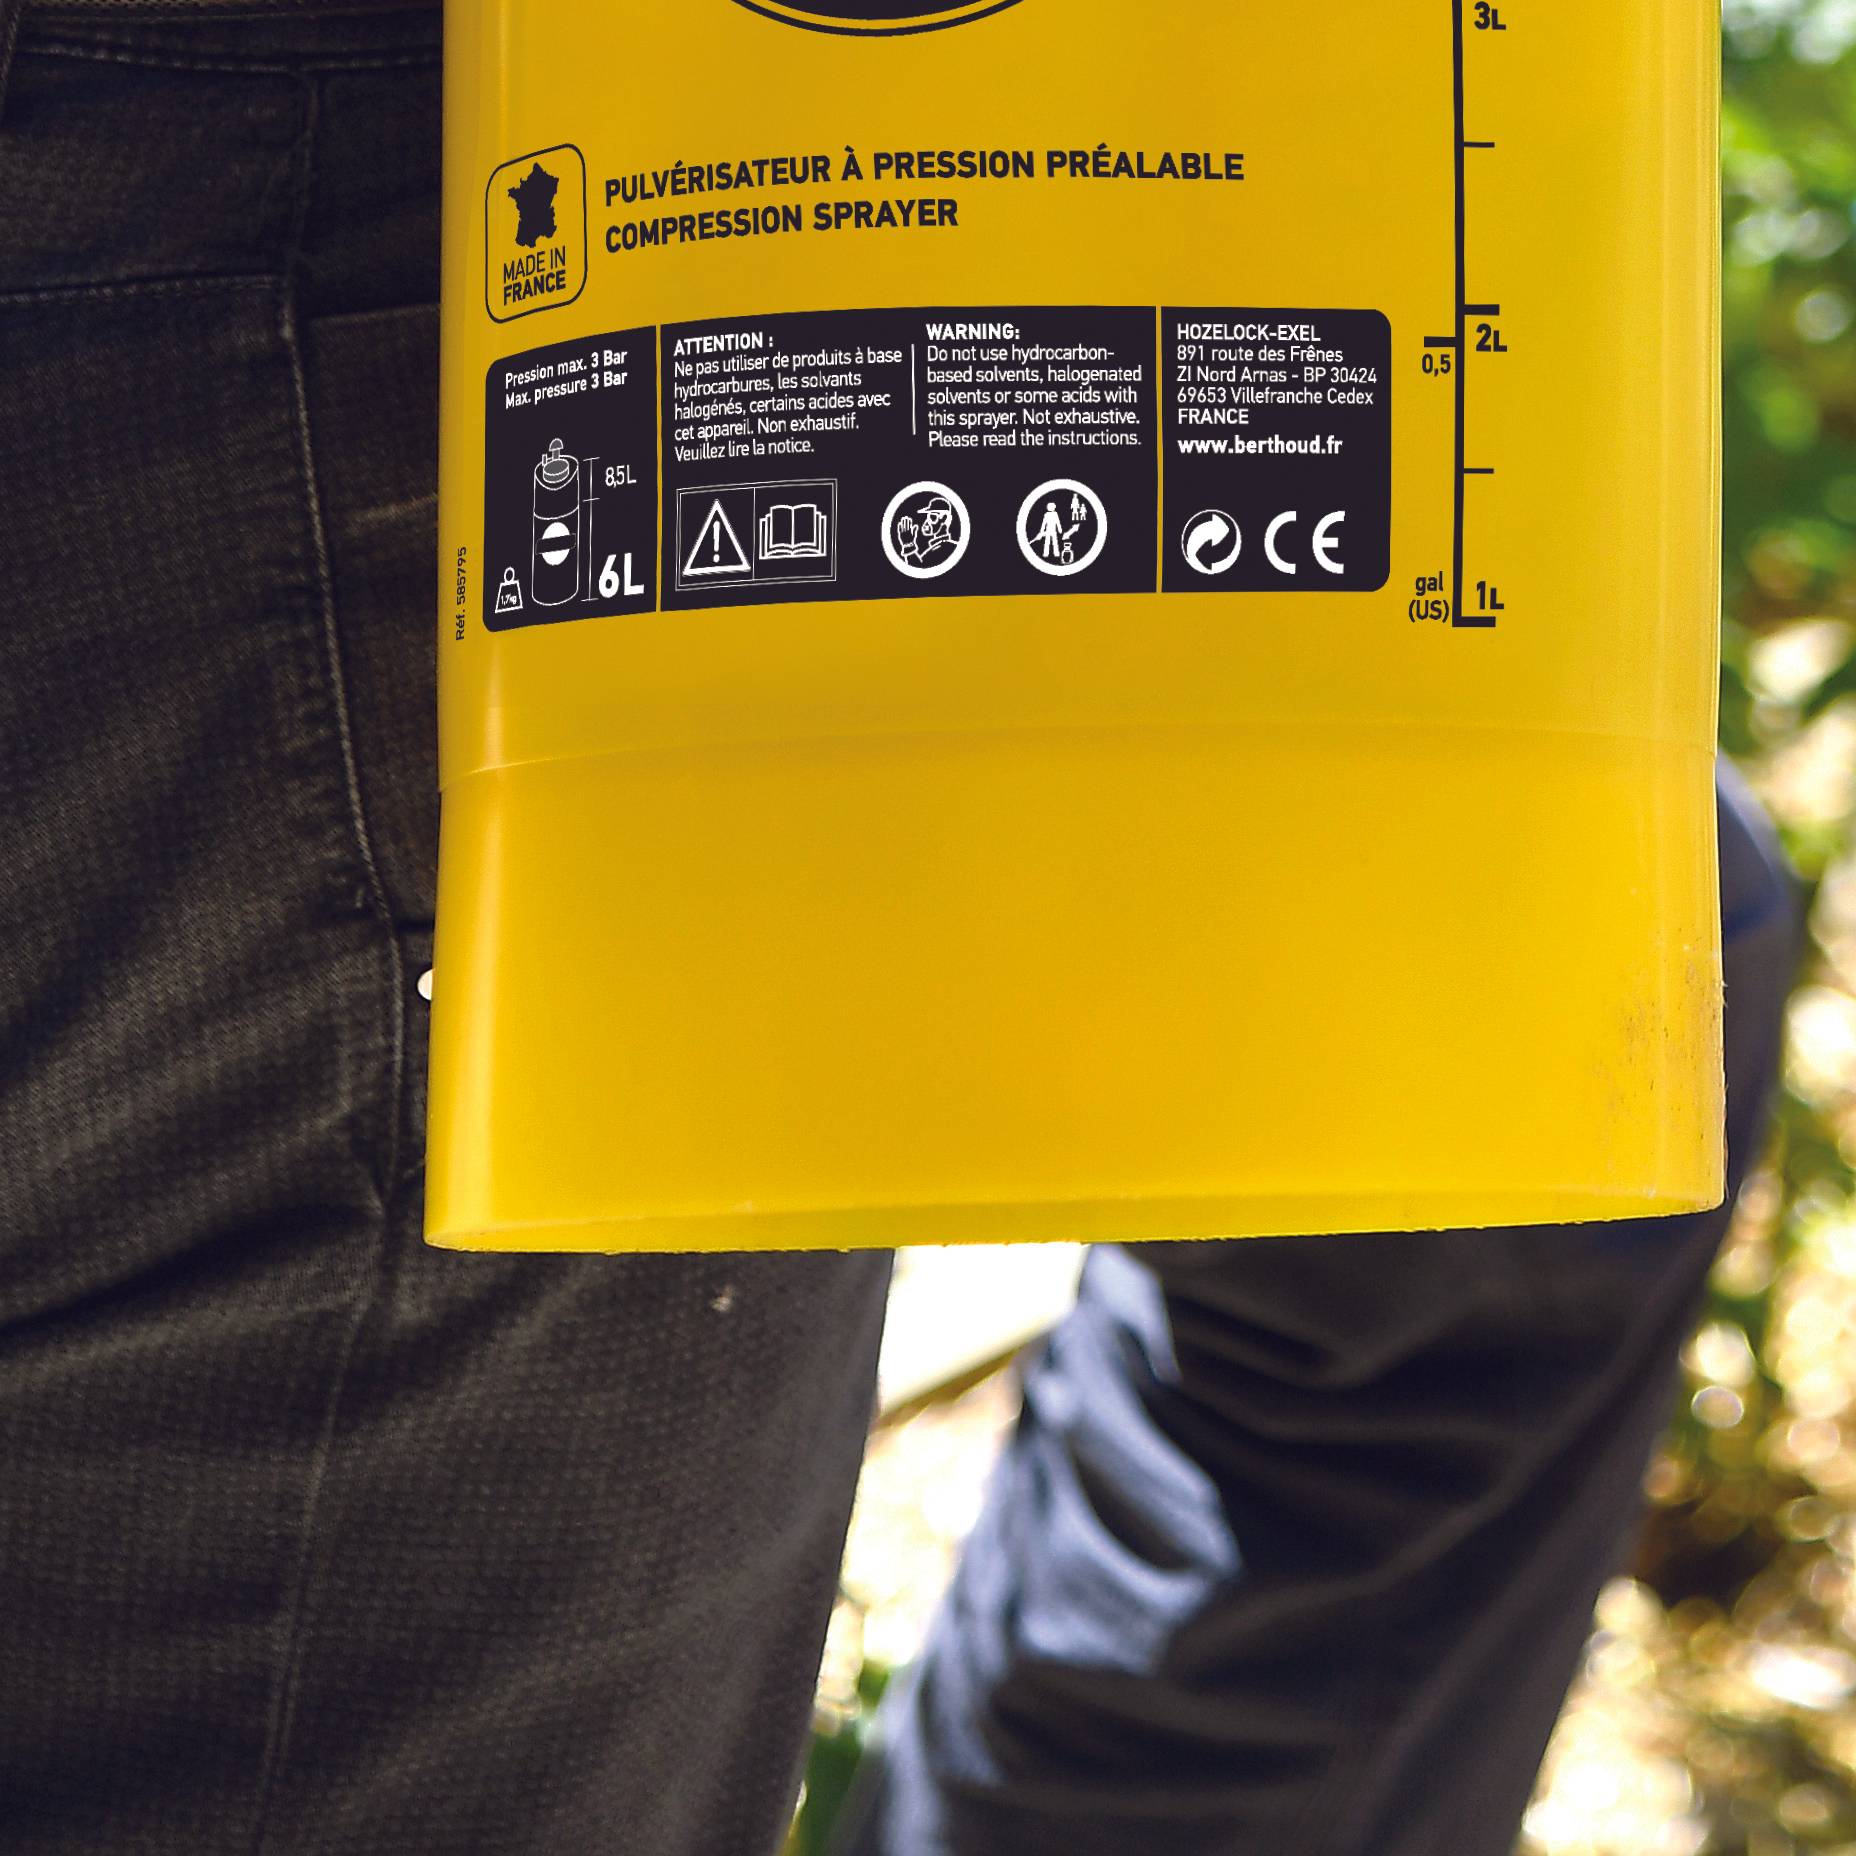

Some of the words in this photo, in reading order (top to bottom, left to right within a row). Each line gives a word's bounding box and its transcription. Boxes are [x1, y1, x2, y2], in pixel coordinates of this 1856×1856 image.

[1472, 1, 1506, 31] 3L
[605, 155, 831, 207] PULVÉRISATEUR
[841, 145, 863, 181] À
[873, 150, 1035, 180] PRESSION
[1046, 142, 1245, 180] PRÉALABLE
[605, 204, 802, 253] COMPRESSION
[813, 198, 958, 230] SPRAYER
[503, 250, 545, 284] MADE
[551, 245, 566, 269] IN
[503, 269, 566, 306] FRANCE
[673, 332, 763, 356] ATTENTION
[926, 323, 1020, 340] WARNING:
[1177, 324, 1321, 342] HOZELOCK-EXEL
[1475, 323, 1508, 353] 2L
[674, 361, 693, 377] Ne
[696, 360, 719, 378] pas
[723, 355, 769, 373] utiliser
[773, 352, 789, 368] de
[793, 349, 851, 371] produits
[855, 347, 863, 363] à
[867, 347, 903, 363] base
[928, 346, 947, 361] Do
[952, 346, 976, 361] not
[980, 347, 1008, 361] use
[1012, 344, 1114, 365] hydrocarbon-
[1177, 345, 1204, 361] 891
[1211, 346, 1253, 362] route
[1258, 345, 1285, 362] des
[1290, 345, 1343, 362] Frênes
[1422, 353, 1451, 376] 0,5
[505, 364, 554, 389] Pression
[558, 358, 587, 377] max.
[591, 351, 598, 368] 3
[604, 349, 627, 367] Bar
[928, 365, 972, 383] based
[976, 365, 1043, 383] solvents,
[1048, 365, 1142, 386] halogenated
[1177, 366, 1191, 382] ZI
[1197, 366, 1236, 382] Nord
[1241, 367, 1287, 382] Arnas
[1304, 367, 1326, 383] BP
[1330, 367, 1377, 384] 30424
[505, 391, 531, 409] Max.
[534, 378, 587, 405] pressure
[591, 373, 599, 388] 3
[604, 370, 627, 387] Bar
[674, 380, 774, 402] hydrocarbures,
[778, 373, 797, 389] les
[801, 371, 862, 388] solvants
[928, 387, 991, 404] solvents
[994, 390, 1011, 403] or
[1014, 389, 1057, 403] some
[1062, 386, 1100, 403] acids
[1104, 386, 1137, 403] with
[1177, 387, 1226, 403] 69653
[1231, 387, 1322, 404] Villefranche
[1327, 387, 1374, 404] Cedex
[674, 398, 746, 421] halogénés,
[750, 394, 805, 413] certains
[809, 392, 854, 409] acides
[857, 392, 891, 407] avec
[928, 410, 955, 426] this
[958, 410, 1018, 429] sprayer.
[1023, 409, 1050, 425] Not
[1054, 408, 1140, 424] exhaustive.
[1178, 408, 1249, 425] FRANCE
[674, 425, 694, 441] cet
[697, 420, 754, 442] appareil.
[758, 418, 786, 434] Non
[790, 412, 859, 432] exhaustif.
[929, 430, 978, 447] Please
[983, 429, 1016, 446] read
[1020, 429, 1044, 446] the
[1048, 429, 1142, 446] instructions.
[675, 444, 725, 462] Veuillez
[728, 440, 749, 457] lire
[753, 439, 765, 455] la
[768, 437, 814, 454] notice.
[1178, 435, 1343, 454] www.berthoud.fr
[605, 465, 637, 488] 8,5L
[456, 547, 467, 605] 585795
[599, 552, 644, 598] 6L
[1414, 571, 1444, 596] gal
[1475, 581, 1504, 610] 1L
[1408, 598, 1450, 623] (US)
[456, 609, 465, 640] Réf.
